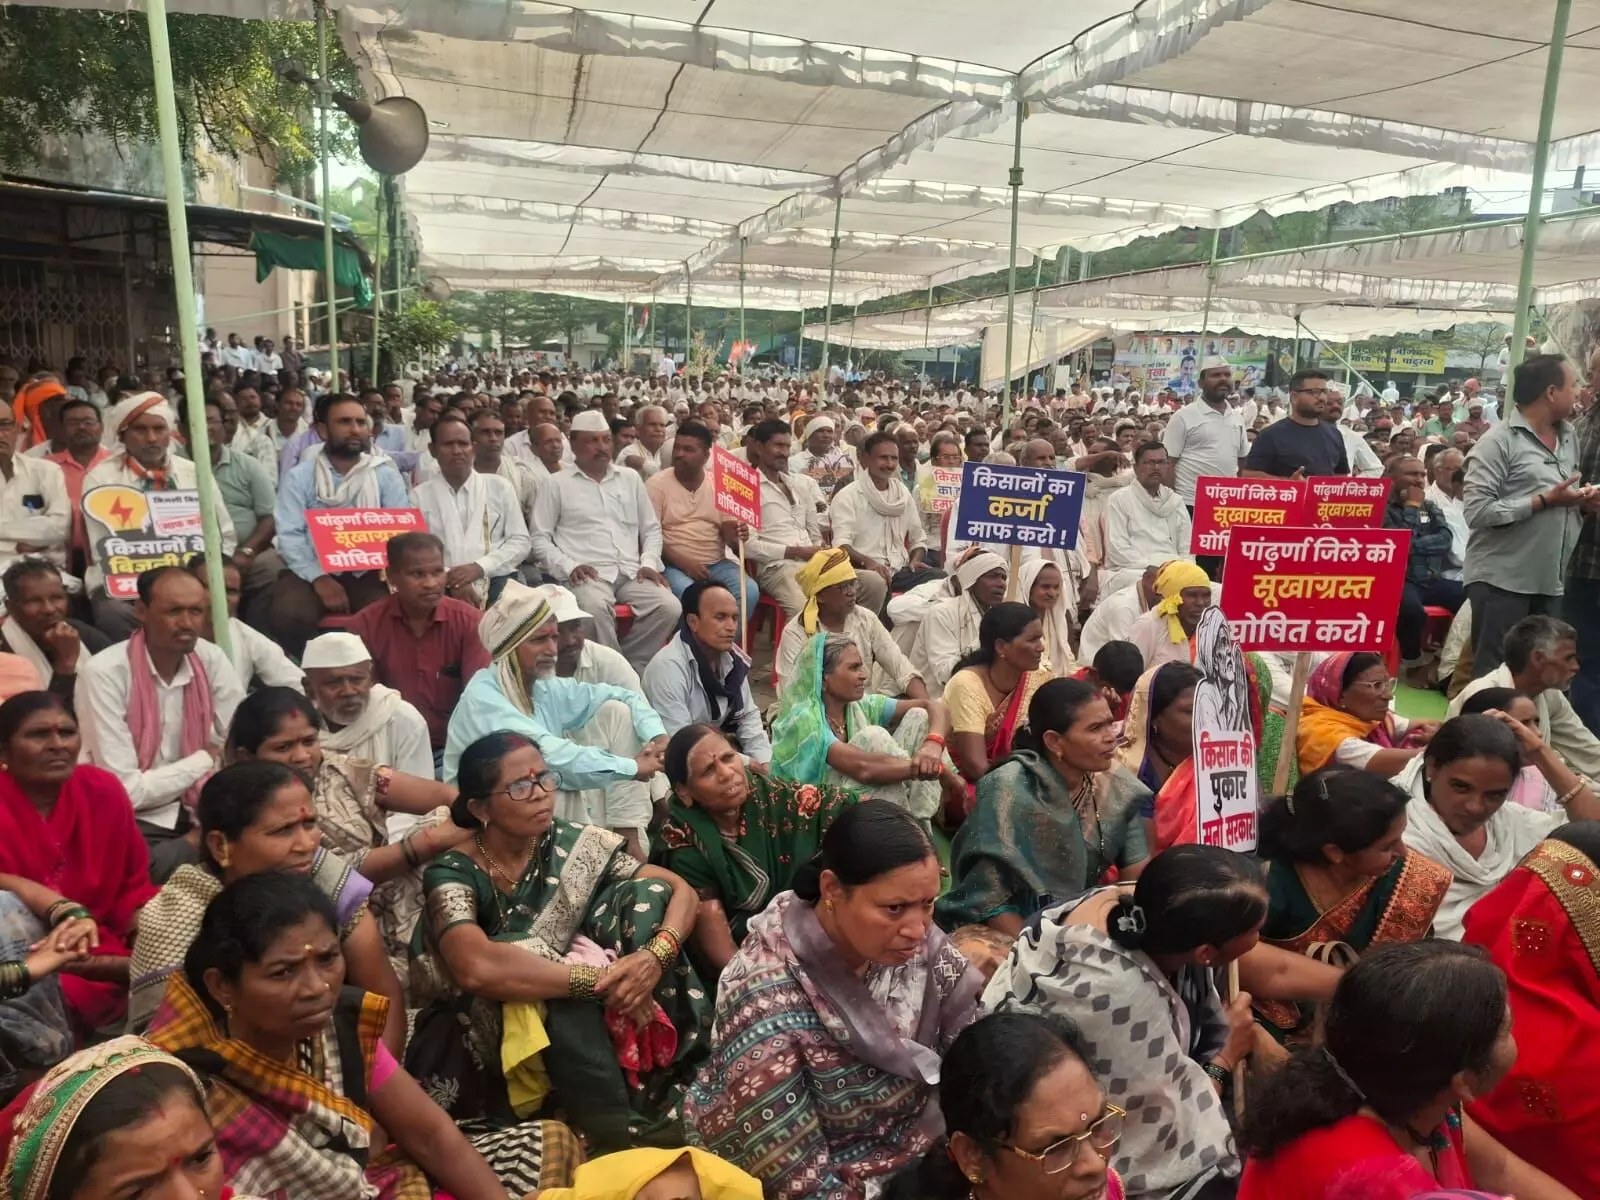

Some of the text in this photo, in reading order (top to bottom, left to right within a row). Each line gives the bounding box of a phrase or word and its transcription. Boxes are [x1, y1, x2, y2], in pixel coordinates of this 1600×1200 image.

[736, 461, 749, 481] जिले
[749, 472, 758, 487] को
[972, 467, 1047, 493] किसानों
[1048, 478, 1075, 496] का
[1206, 483, 1298, 505] पांढुर्णा जिले को
[1313, 481, 1385, 502] पांढुर्णा जिले को
[717, 491, 740, 516] घोषित
[740, 505, 755, 525] करो
[988, 495, 1053, 521] कर्जा
[1213, 506, 1286, 528] सूखाग्रस्त
[1317, 503, 1374, 521] सूखाग्रस्त
[315, 512, 416, 531] पांढुर्णा जिले को
[967, 520, 1067, 545] माफ करो !
[105, 536, 186, 555] किसानों
[325, 549, 384, 567] घोषित
[1241, 536, 1396, 571] पांढुर्णा जिले को
[1253, 575, 1375, 608] सूखाग्रस्त
[1228, 611, 1385, 644] घोषित करो !
[1200, 731, 1253, 770] किसान की
[1210, 771, 1247, 813] पुकार
